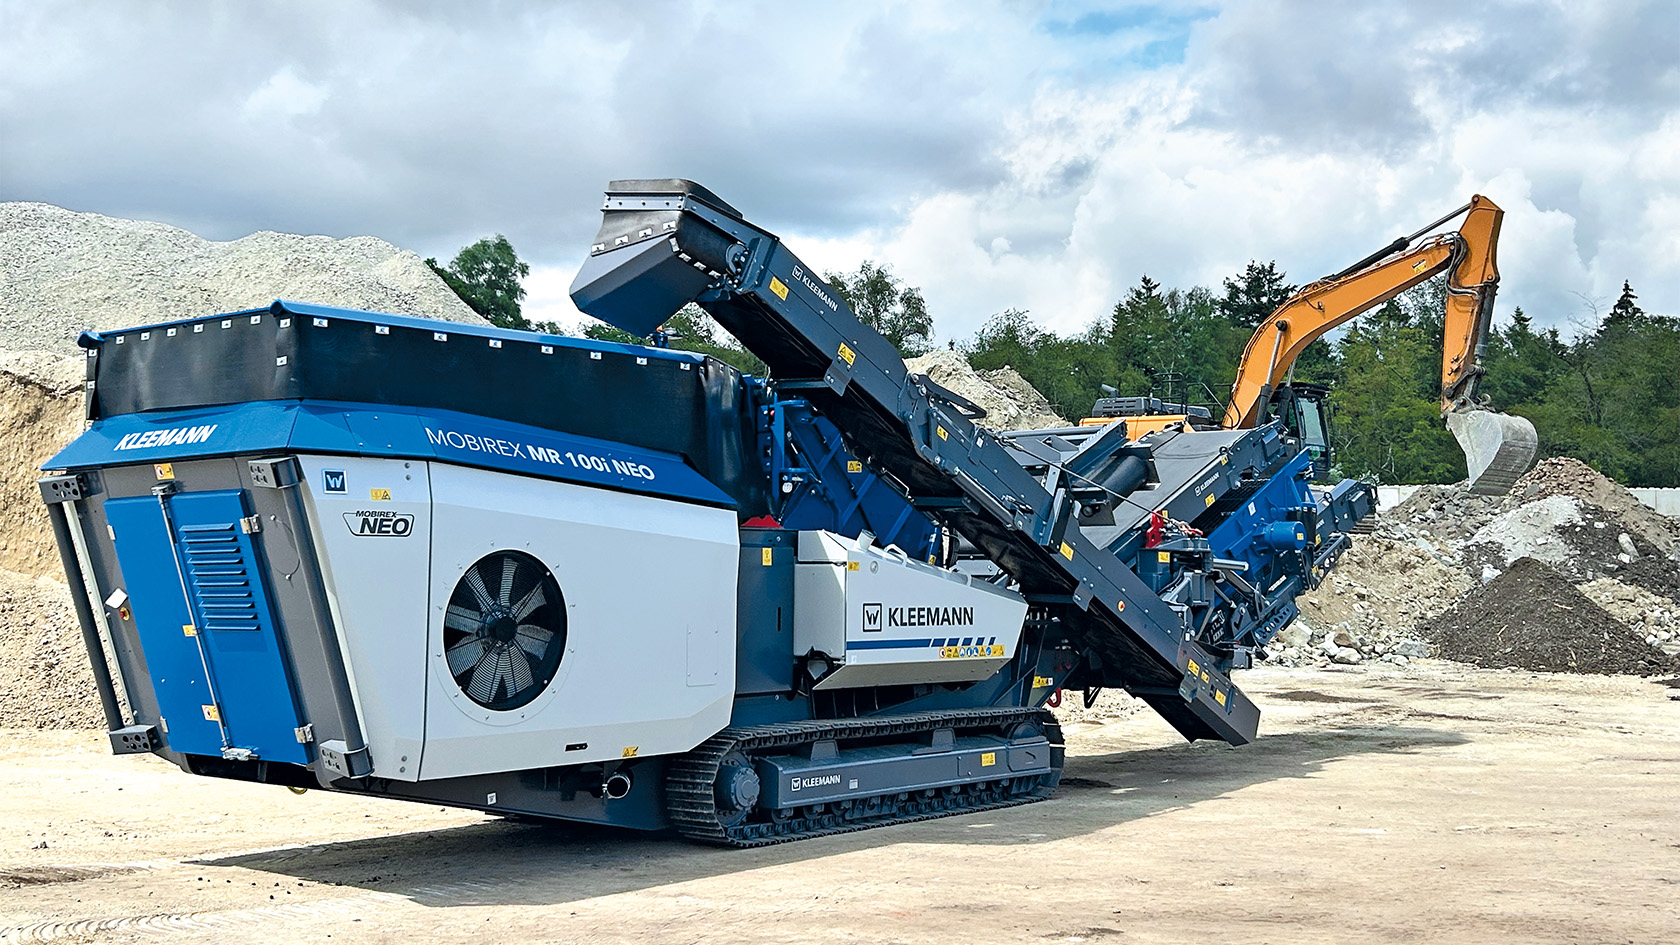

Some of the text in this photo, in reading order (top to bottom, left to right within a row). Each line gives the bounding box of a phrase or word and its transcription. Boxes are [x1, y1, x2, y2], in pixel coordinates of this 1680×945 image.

[802, 275, 838, 312] KLEEMANN
[113, 424, 218, 451] KLEEMANN
[425, 427, 655, 480] MOBIREX MR 100i NEO
[355, 510, 398, 518] MOBIREX
[359, 518, 409, 534] NEO
[888, 607, 974, 627] KLEEMANN
[802, 774, 841, 788] KLEEMANN
